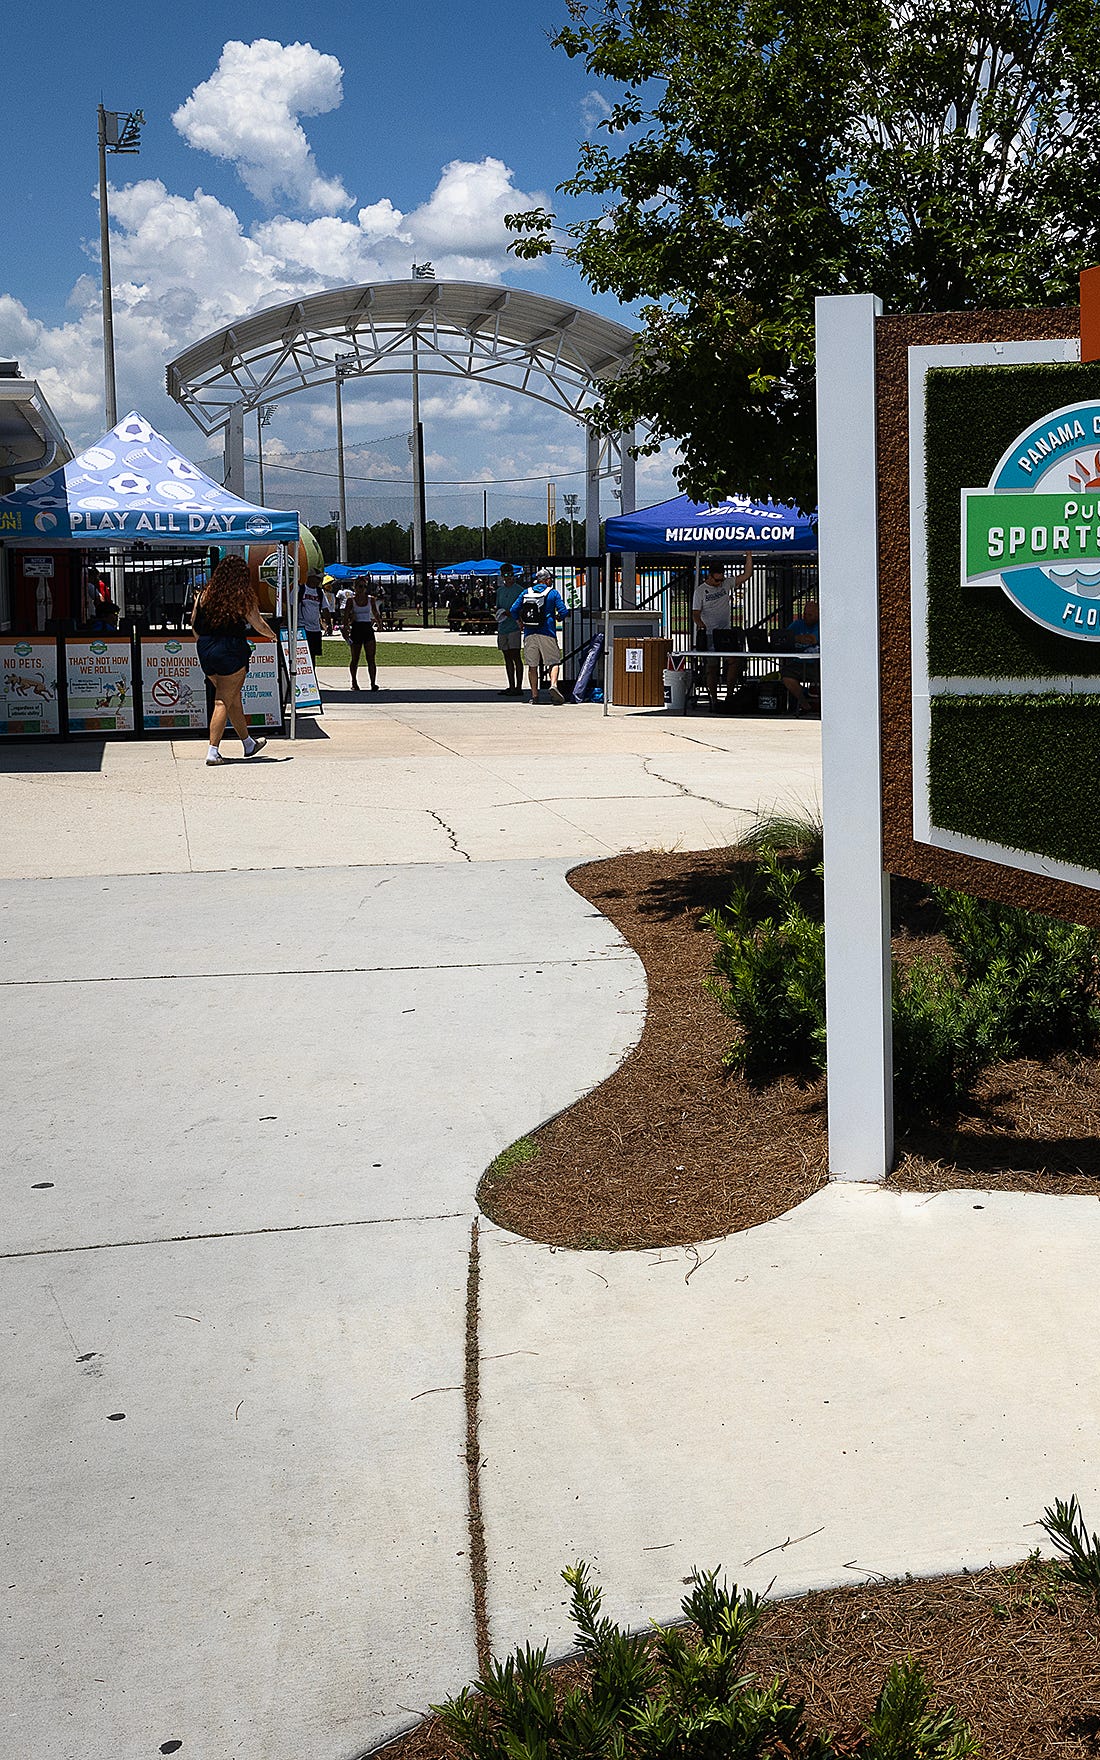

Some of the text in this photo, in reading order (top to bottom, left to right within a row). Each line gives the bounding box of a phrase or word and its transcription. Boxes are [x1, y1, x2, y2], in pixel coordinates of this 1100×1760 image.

[1018, 419, 1085, 473] PANAMA
[70, 512, 130, 530] PLAY
[136, 512, 180, 531] ALL
[188, 513, 237, 532] DAY
[665, 526, 795, 542] MIZUNOUSA.COM
[4, 658, 16, 669] NO
[68, 656, 129, 666] THAT'S NOT HOW
[146, 657, 158, 667] NO
[257, 655, 275, 664] ITEMS
[80, 666, 93, 674] WE
[157, 667, 190, 677] PLEASE
